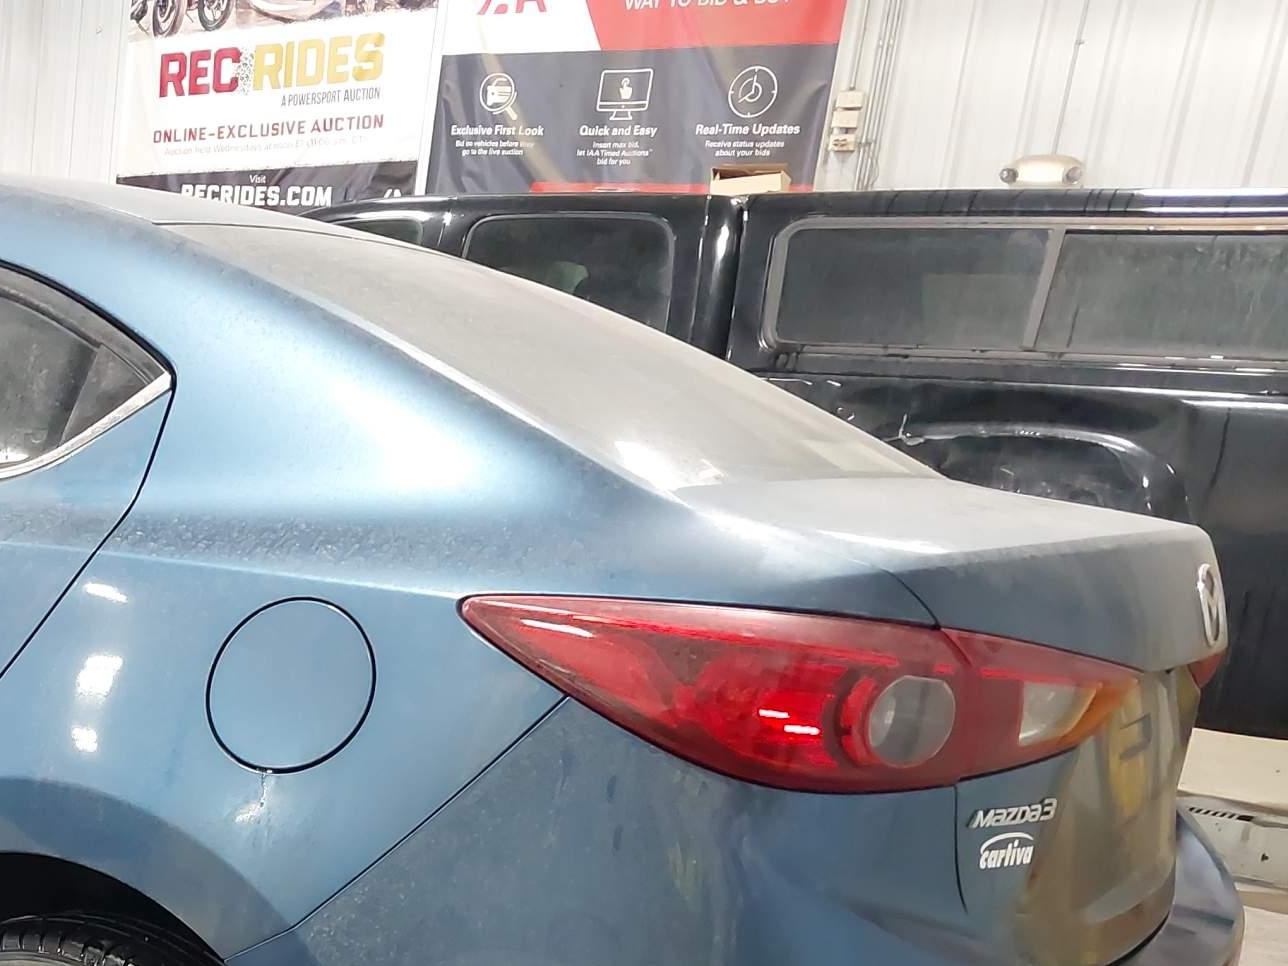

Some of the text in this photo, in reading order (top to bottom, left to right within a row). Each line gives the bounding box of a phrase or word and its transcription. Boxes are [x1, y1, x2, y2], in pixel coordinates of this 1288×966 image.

[159, 32, 386, 98] REC RIDES
[280, 87, 380, 107] A POWERSPORT AUCTION
[153, 114, 384, 144] ONLINE-EXCLUSIVE AUCTION
[450, 124, 545, 136] Exclusive First Look
[579, 125, 658, 137] Quick and Easy
[695, 123, 801, 136] Real-Time Updates
[755, 140, 785, 148] updates
[715, 149, 736, 157] about
[736, 150, 754, 158] your
[596, 158, 608, 166] bid
[249, 174, 267, 184] Visit
[979, 839, 1034, 870] cartiva
